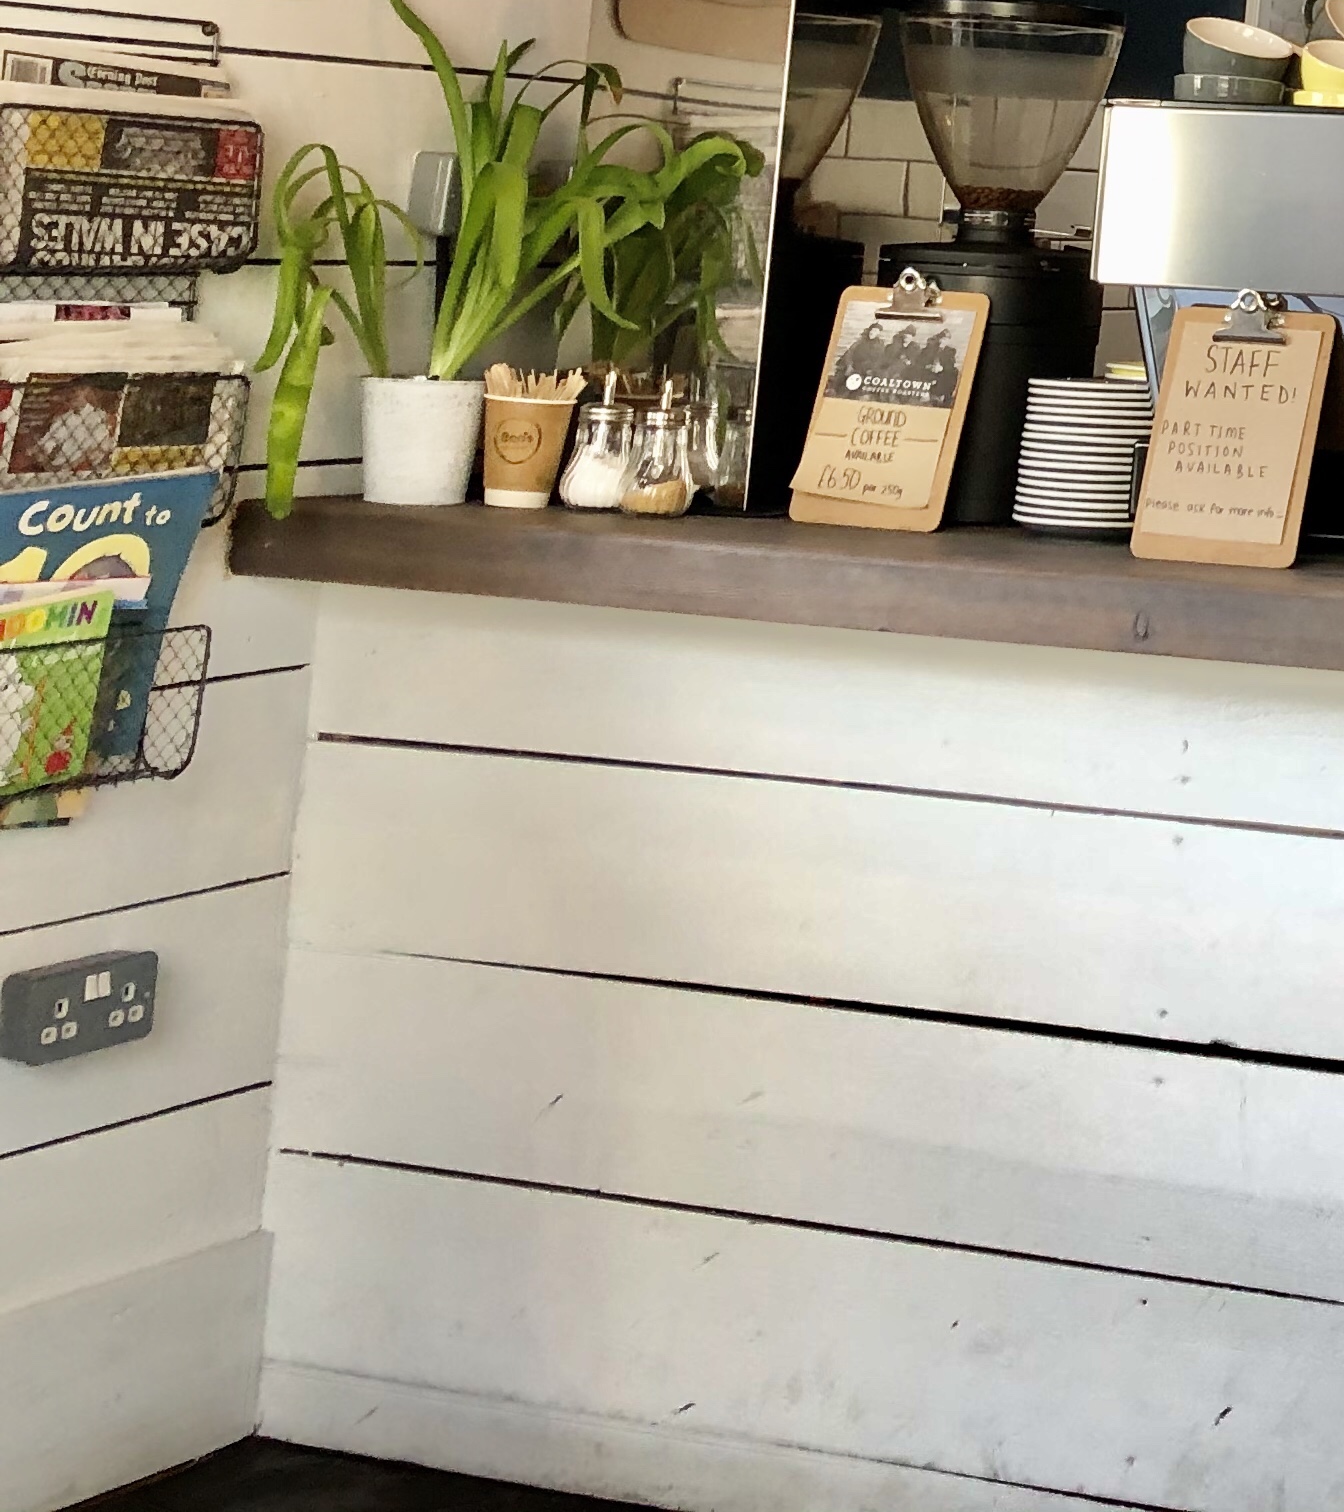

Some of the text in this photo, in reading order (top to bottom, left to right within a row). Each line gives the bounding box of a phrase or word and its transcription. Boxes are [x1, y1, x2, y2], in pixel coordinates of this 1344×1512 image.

[1206, 344, 1281, 378] STAFF
[862, 376, 932, 391] COALTOWN
[1185, 380, 1297, 405] WANTED!
[857, 405, 907, 428] GROUND
[851, 428, 900, 448] COFFEE
[1161, 419, 1246, 440] PART TIME
[845, 449, 895, 464] AVAILABLE
[1168, 440, 1244, 458] POSITION
[1175, 460, 1268, 479] AVAILABLE
[19, 492, 172, 537] Count to
